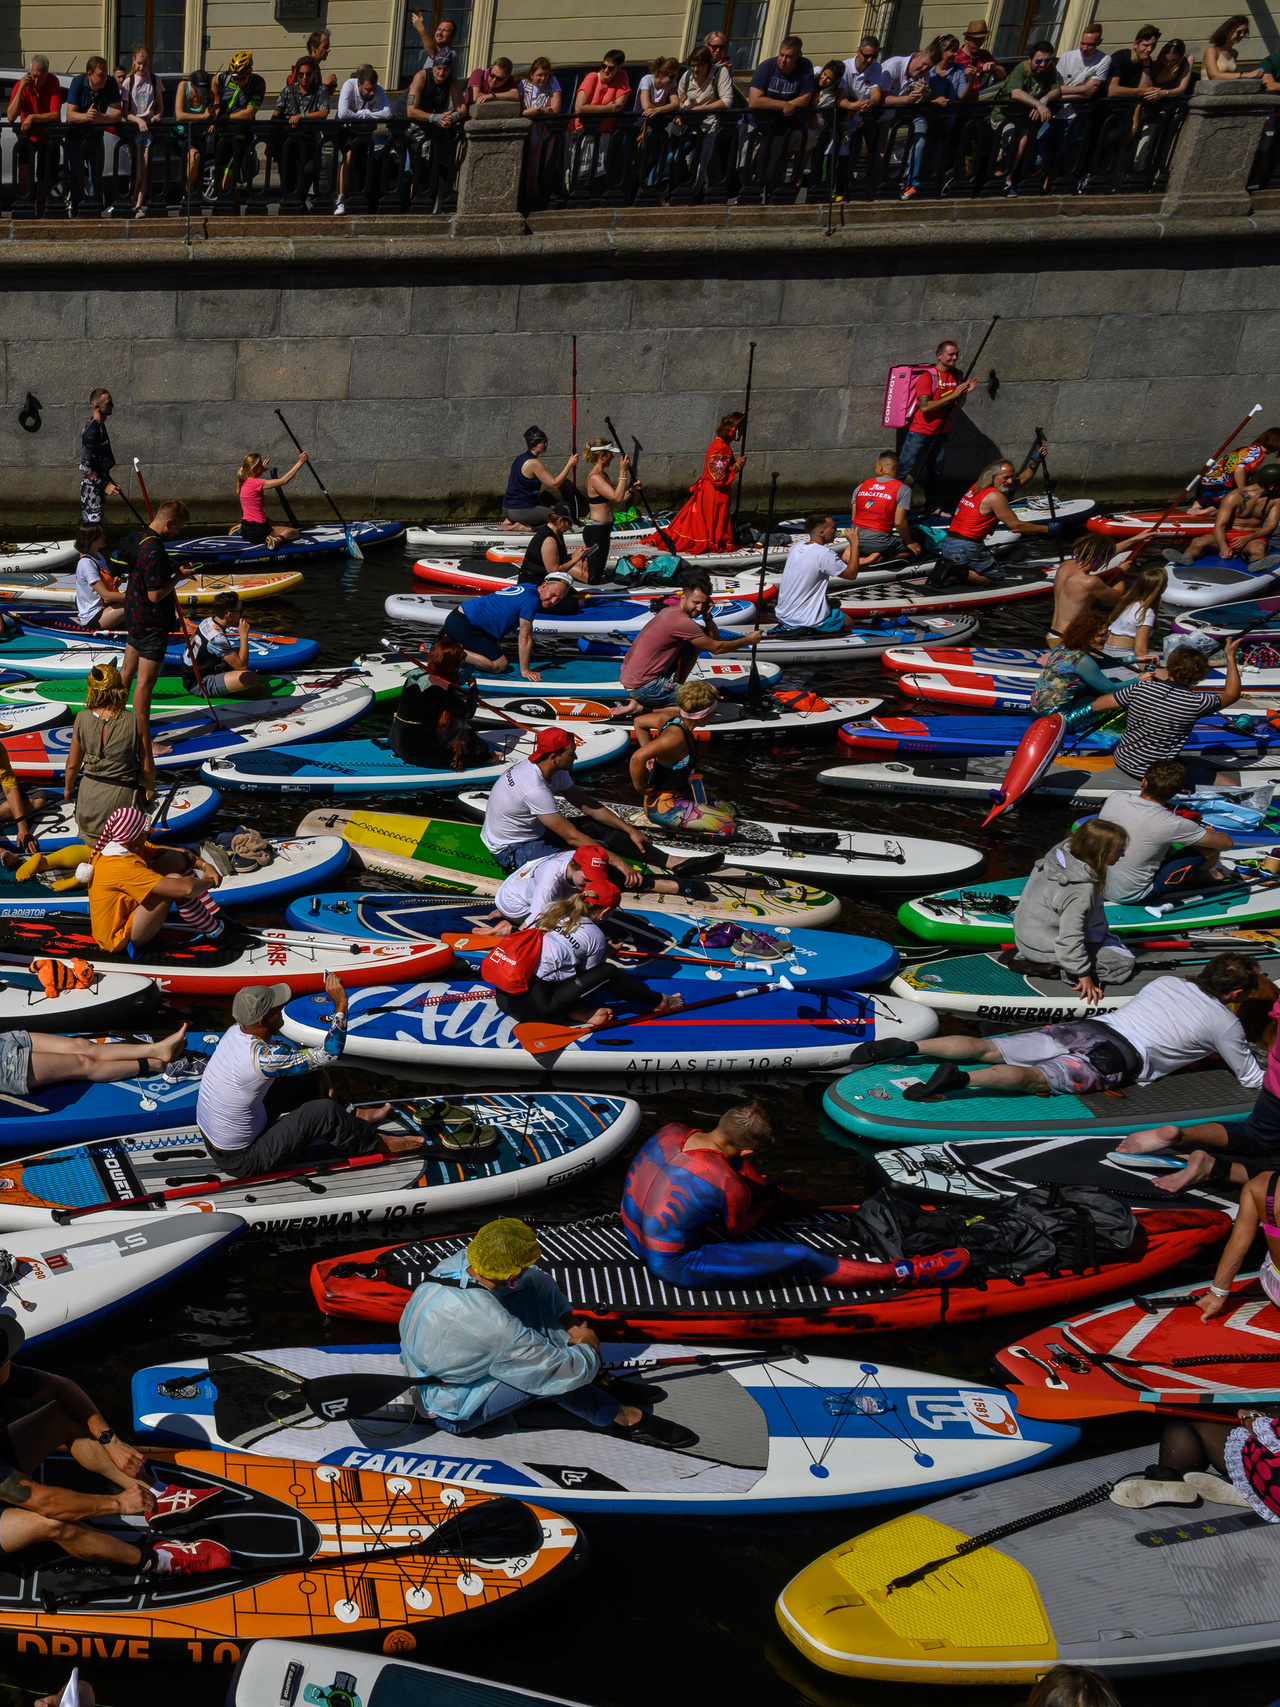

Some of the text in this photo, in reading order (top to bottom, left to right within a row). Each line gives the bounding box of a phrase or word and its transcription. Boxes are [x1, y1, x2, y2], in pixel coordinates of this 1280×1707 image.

[857, 490, 892, 501] СПАСАТЕЛЬ
[2, 565, 21, 574] 10.8
[1, 907, 47, 918] GLADIATOR
[976, 1004, 1078, 1019] POWERMAX
[626, 1056, 793, 1072] ATLAS FIT 10.8
[98, 1147, 136, 1200] POWER
[383, 1201, 428, 1220] 10.6
[971, 1396, 986, 1420] 1581
[342, 1450, 494, 1483] FANATIC
